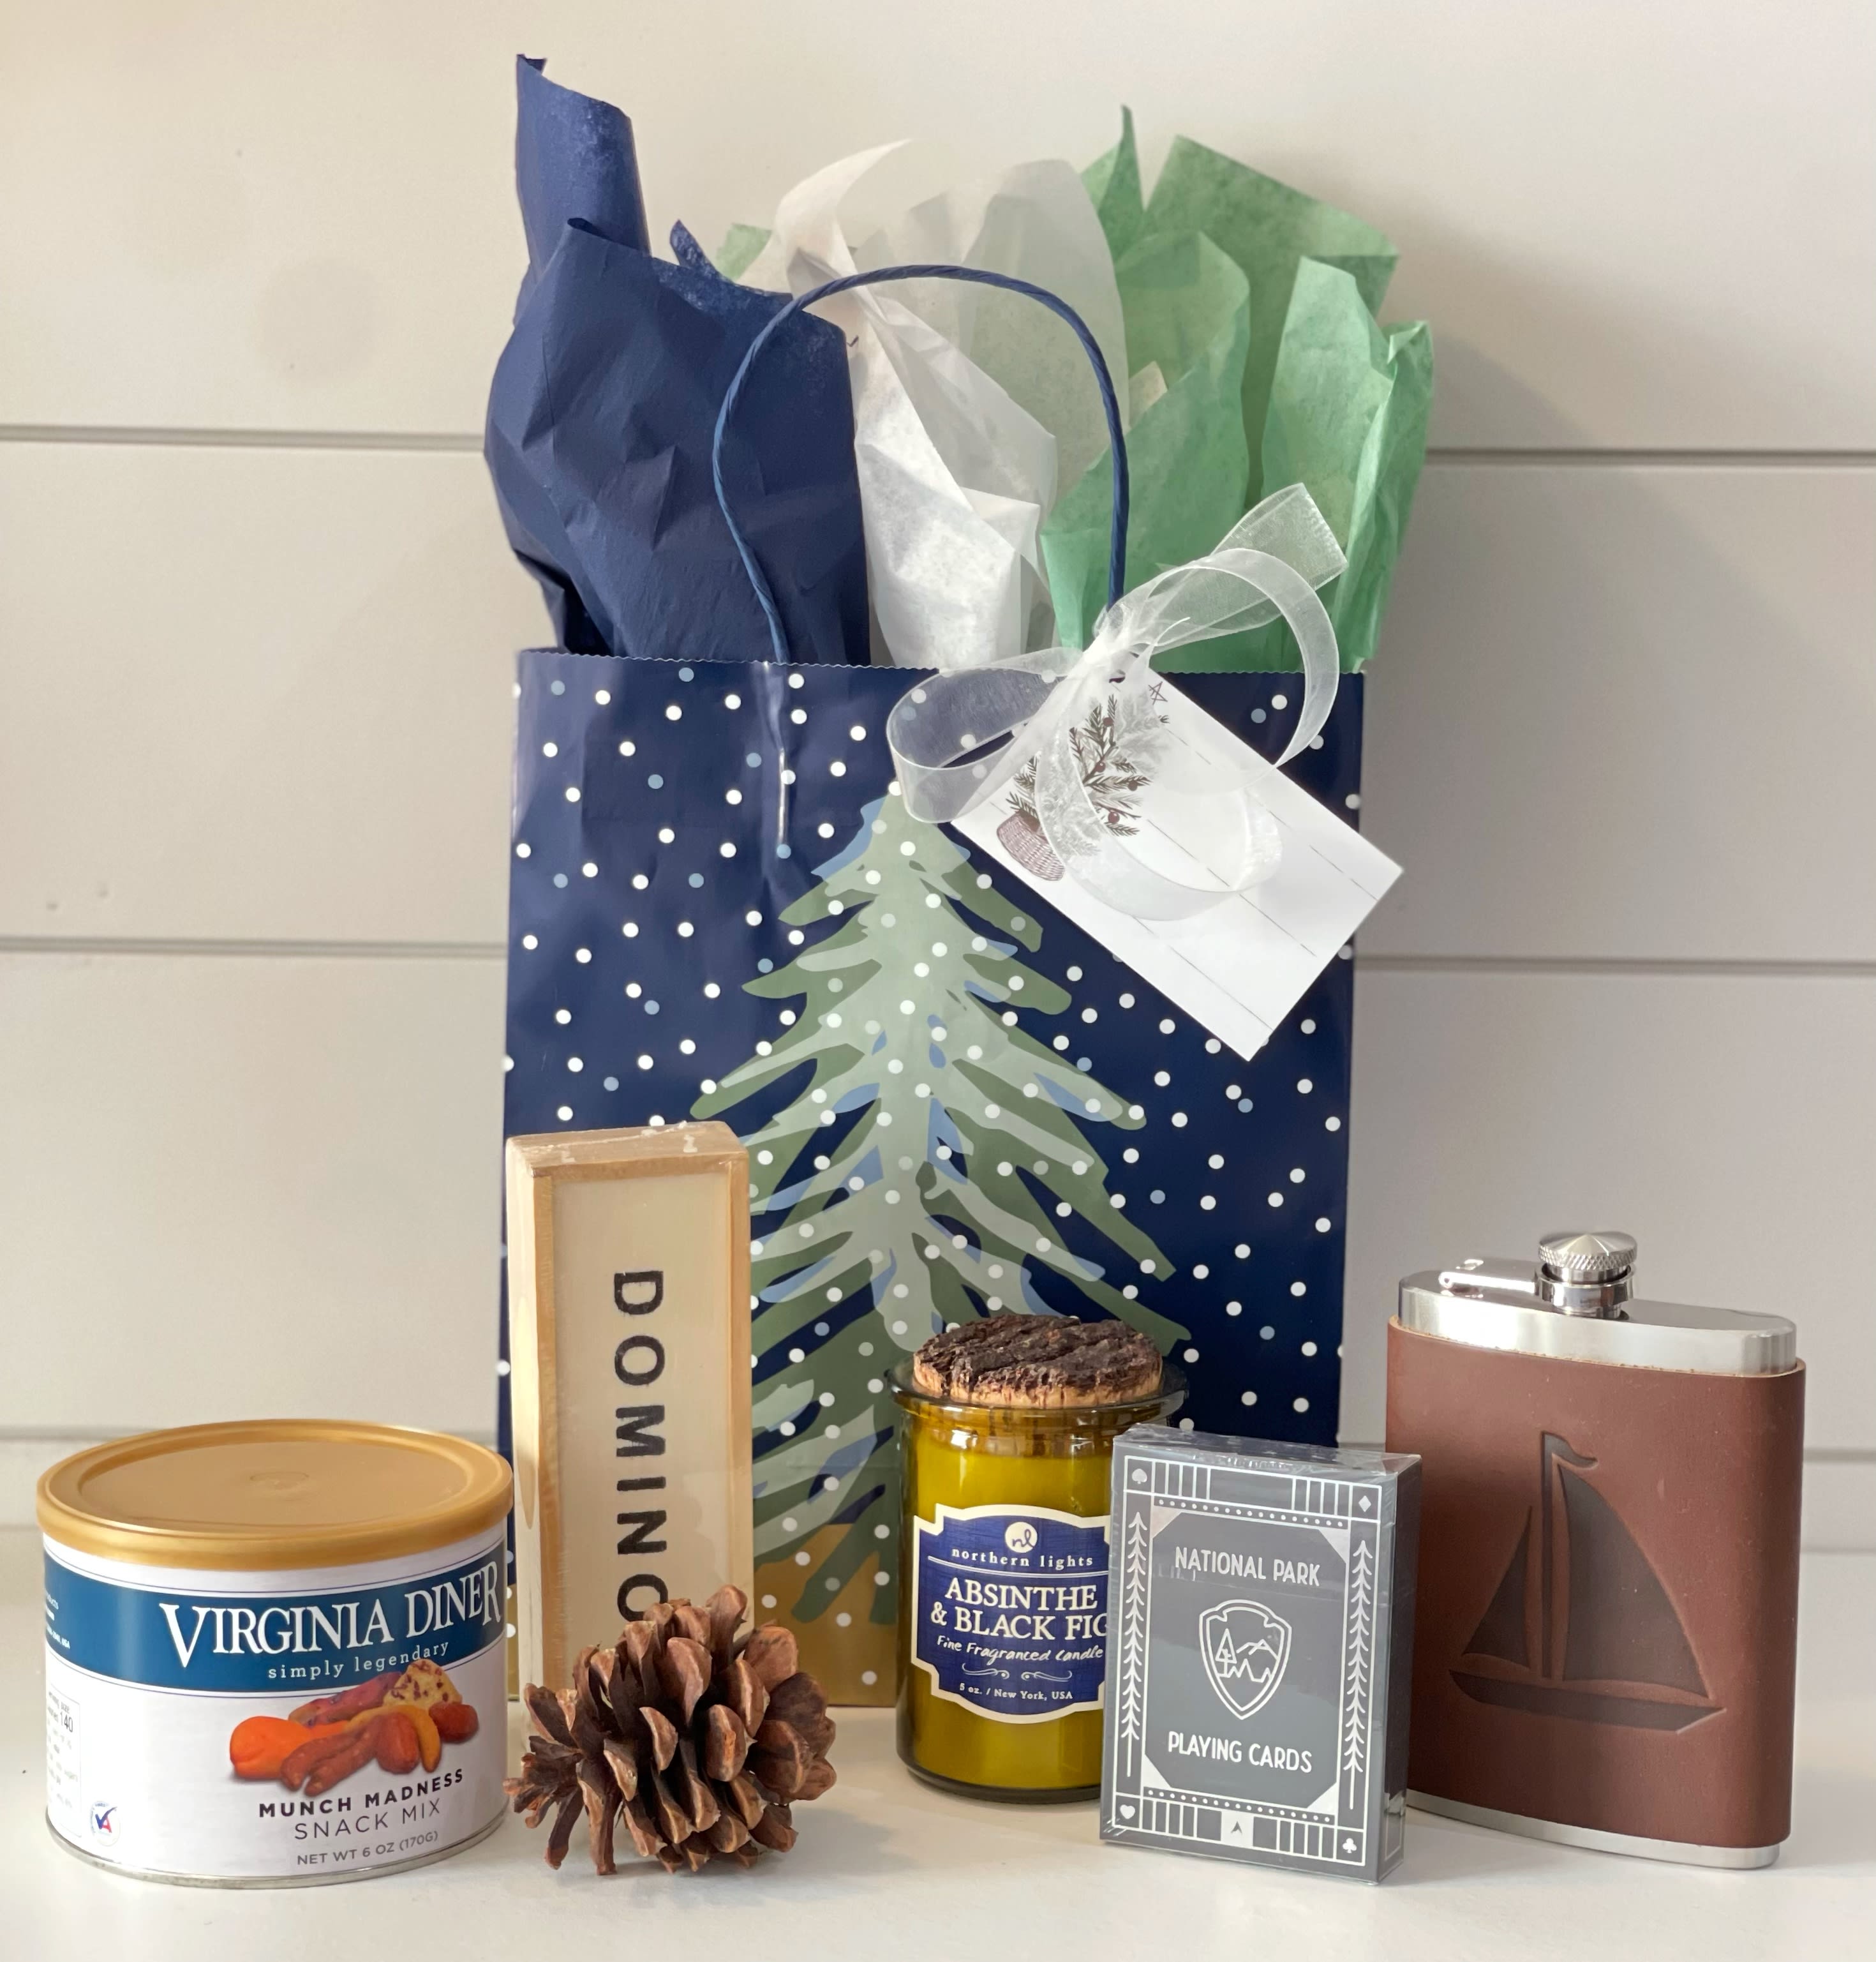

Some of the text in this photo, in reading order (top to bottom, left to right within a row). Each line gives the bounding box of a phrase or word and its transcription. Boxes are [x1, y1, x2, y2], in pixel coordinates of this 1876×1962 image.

[614, 1270, 669, 1622] DOMINO
[952, 1549, 1093, 1570] northern lights
[1175, 1546, 1320, 1587] NATIONAL PARK
[944, 1577, 1098, 1611] ABSINTHE
[160, 1561, 502, 1668] VIRGINIA DINER
[931, 1602, 947, 1626] &
[954, 1607, 1055, 1640] BLACK
[269, 1641, 449, 1680] simply legendary
[937, 1635, 1103, 1666] Fine Fragranced Candle
[968, 1687, 983, 1695] oz.
[994, 1689, 1016, 1699] New
[1020, 1691, 1047, 1701] York,
[1052, 1691, 1073, 1700] USA
[61, 1711, 73, 1733] 140
[1168, 1731, 1312, 1773] PLAYING CARDS
[259, 1768, 463, 1817] MUNCH MADNESS
[294, 1798, 440, 1839] SNACK MIX
[297, 1831, 438, 1865] NET WT 6 OZ (170G)
